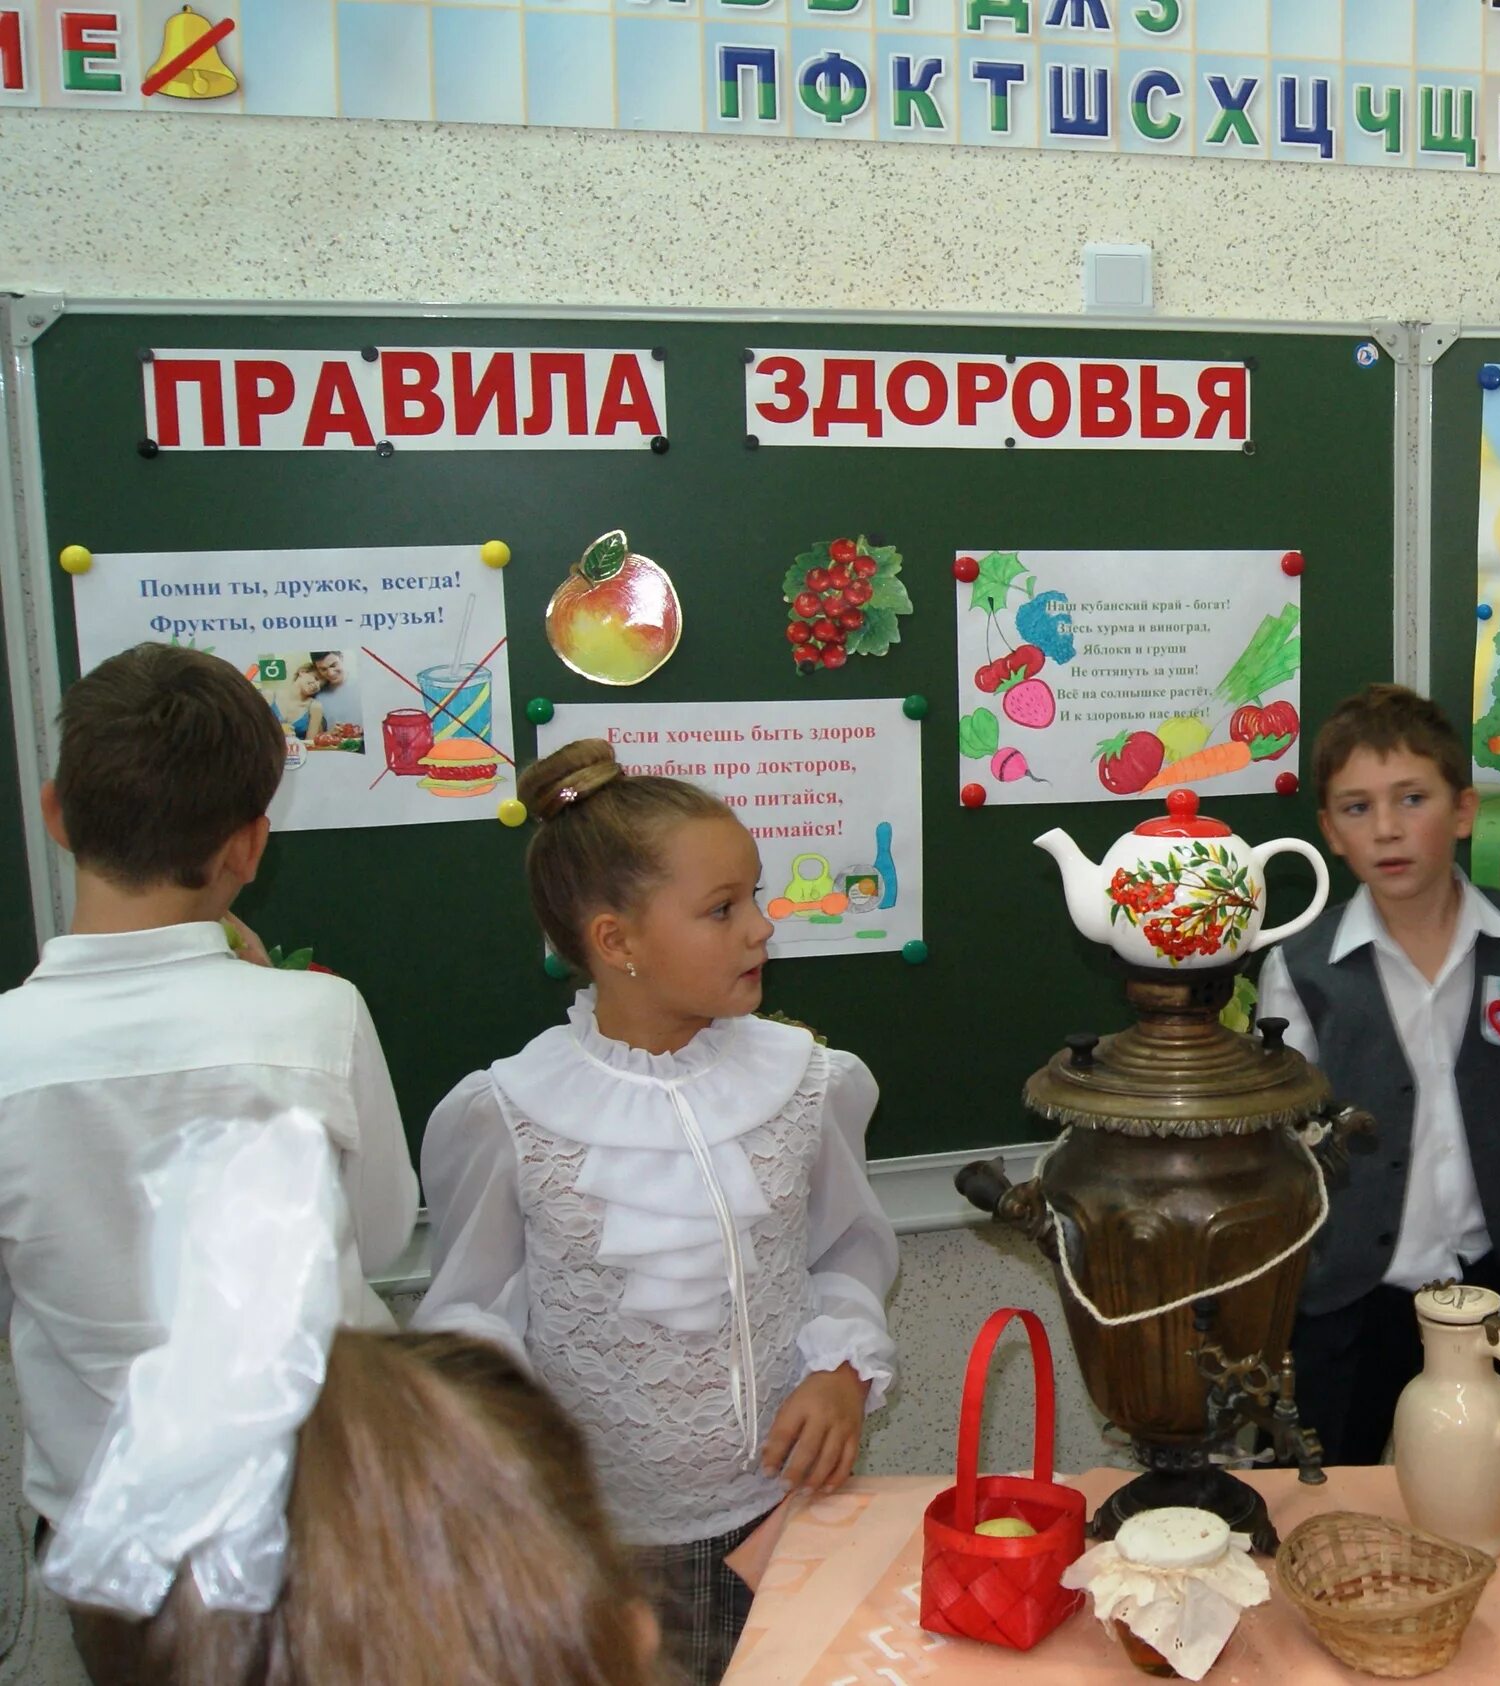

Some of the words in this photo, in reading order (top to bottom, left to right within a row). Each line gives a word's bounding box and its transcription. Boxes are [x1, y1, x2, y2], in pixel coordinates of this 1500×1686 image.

[61, 12, 122, 91] Е
[719, 46, 777, 120] П
[799, 52, 867, 123] Ф
[893, 56, 944, 128] К
[973, 61, 1024, 131] Т
[1049, 66, 1109, 136] Ш
[1132, 70, 1182, 140] С
[1206, 75, 1260, 145] Х
[1280, 77, 1333, 158] Ц
[1355, 86, 1401, 152] Ч
[1421, 86, 1476, 166] Щ
[153, 351, 661, 447] ПРАВИЛА
[755, 355, 1247, 440] ЗДОРОВЬЯ
[139, 579, 220, 597] Помни
[228, 581, 268, 598] ты,
[275, 577, 368, 597] дружок,
[381, 571, 461, 591] всегда!
[1047, 601, 1077, 612] Наш
[1081, 601, 1149, 614] кубанский
[1152, 600, 1182, 613] край
[1194, 599, 1231, 611] богат!
[149, 614, 255, 637] Фрукты,
[262, 613, 337, 631] овощи
[360, 606, 444, 629] друзья!
[1097, 624, 1135, 635] хурма
[1139, 624, 1146, 632] и
[1084, 643, 1131, 656] Яблоки
[1135, 646, 1143, 654] и
[1147, 645, 1186, 656] груши
[1071, 666, 1087, 677] Не
[1091, 668, 1149, 679] оттянуть
[1154, 667, 1165, 676] за
[1168, 665, 1199, 679] уши!
[1057, 688, 1078, 700] Всё
[1082, 690, 1096, 699] на
[1100, 688, 1167, 699] солнышке
[1060, 711, 1070, 721] И
[1074, 713, 1082, 721] к
[1086, 711, 1145, 722] здоровью
[1150, 710, 1170, 720] нас
[1173, 707, 1210, 719] ведёт!
[607, 727, 658, 743] Если
[666, 728, 744, 743] хочешь
[751, 725, 803, 741] быть
[809, 725, 876, 745] здоров
[713, 761, 750, 779] про
[756, 758, 857, 777] докторов,
[754, 789, 843, 807] питайся,
